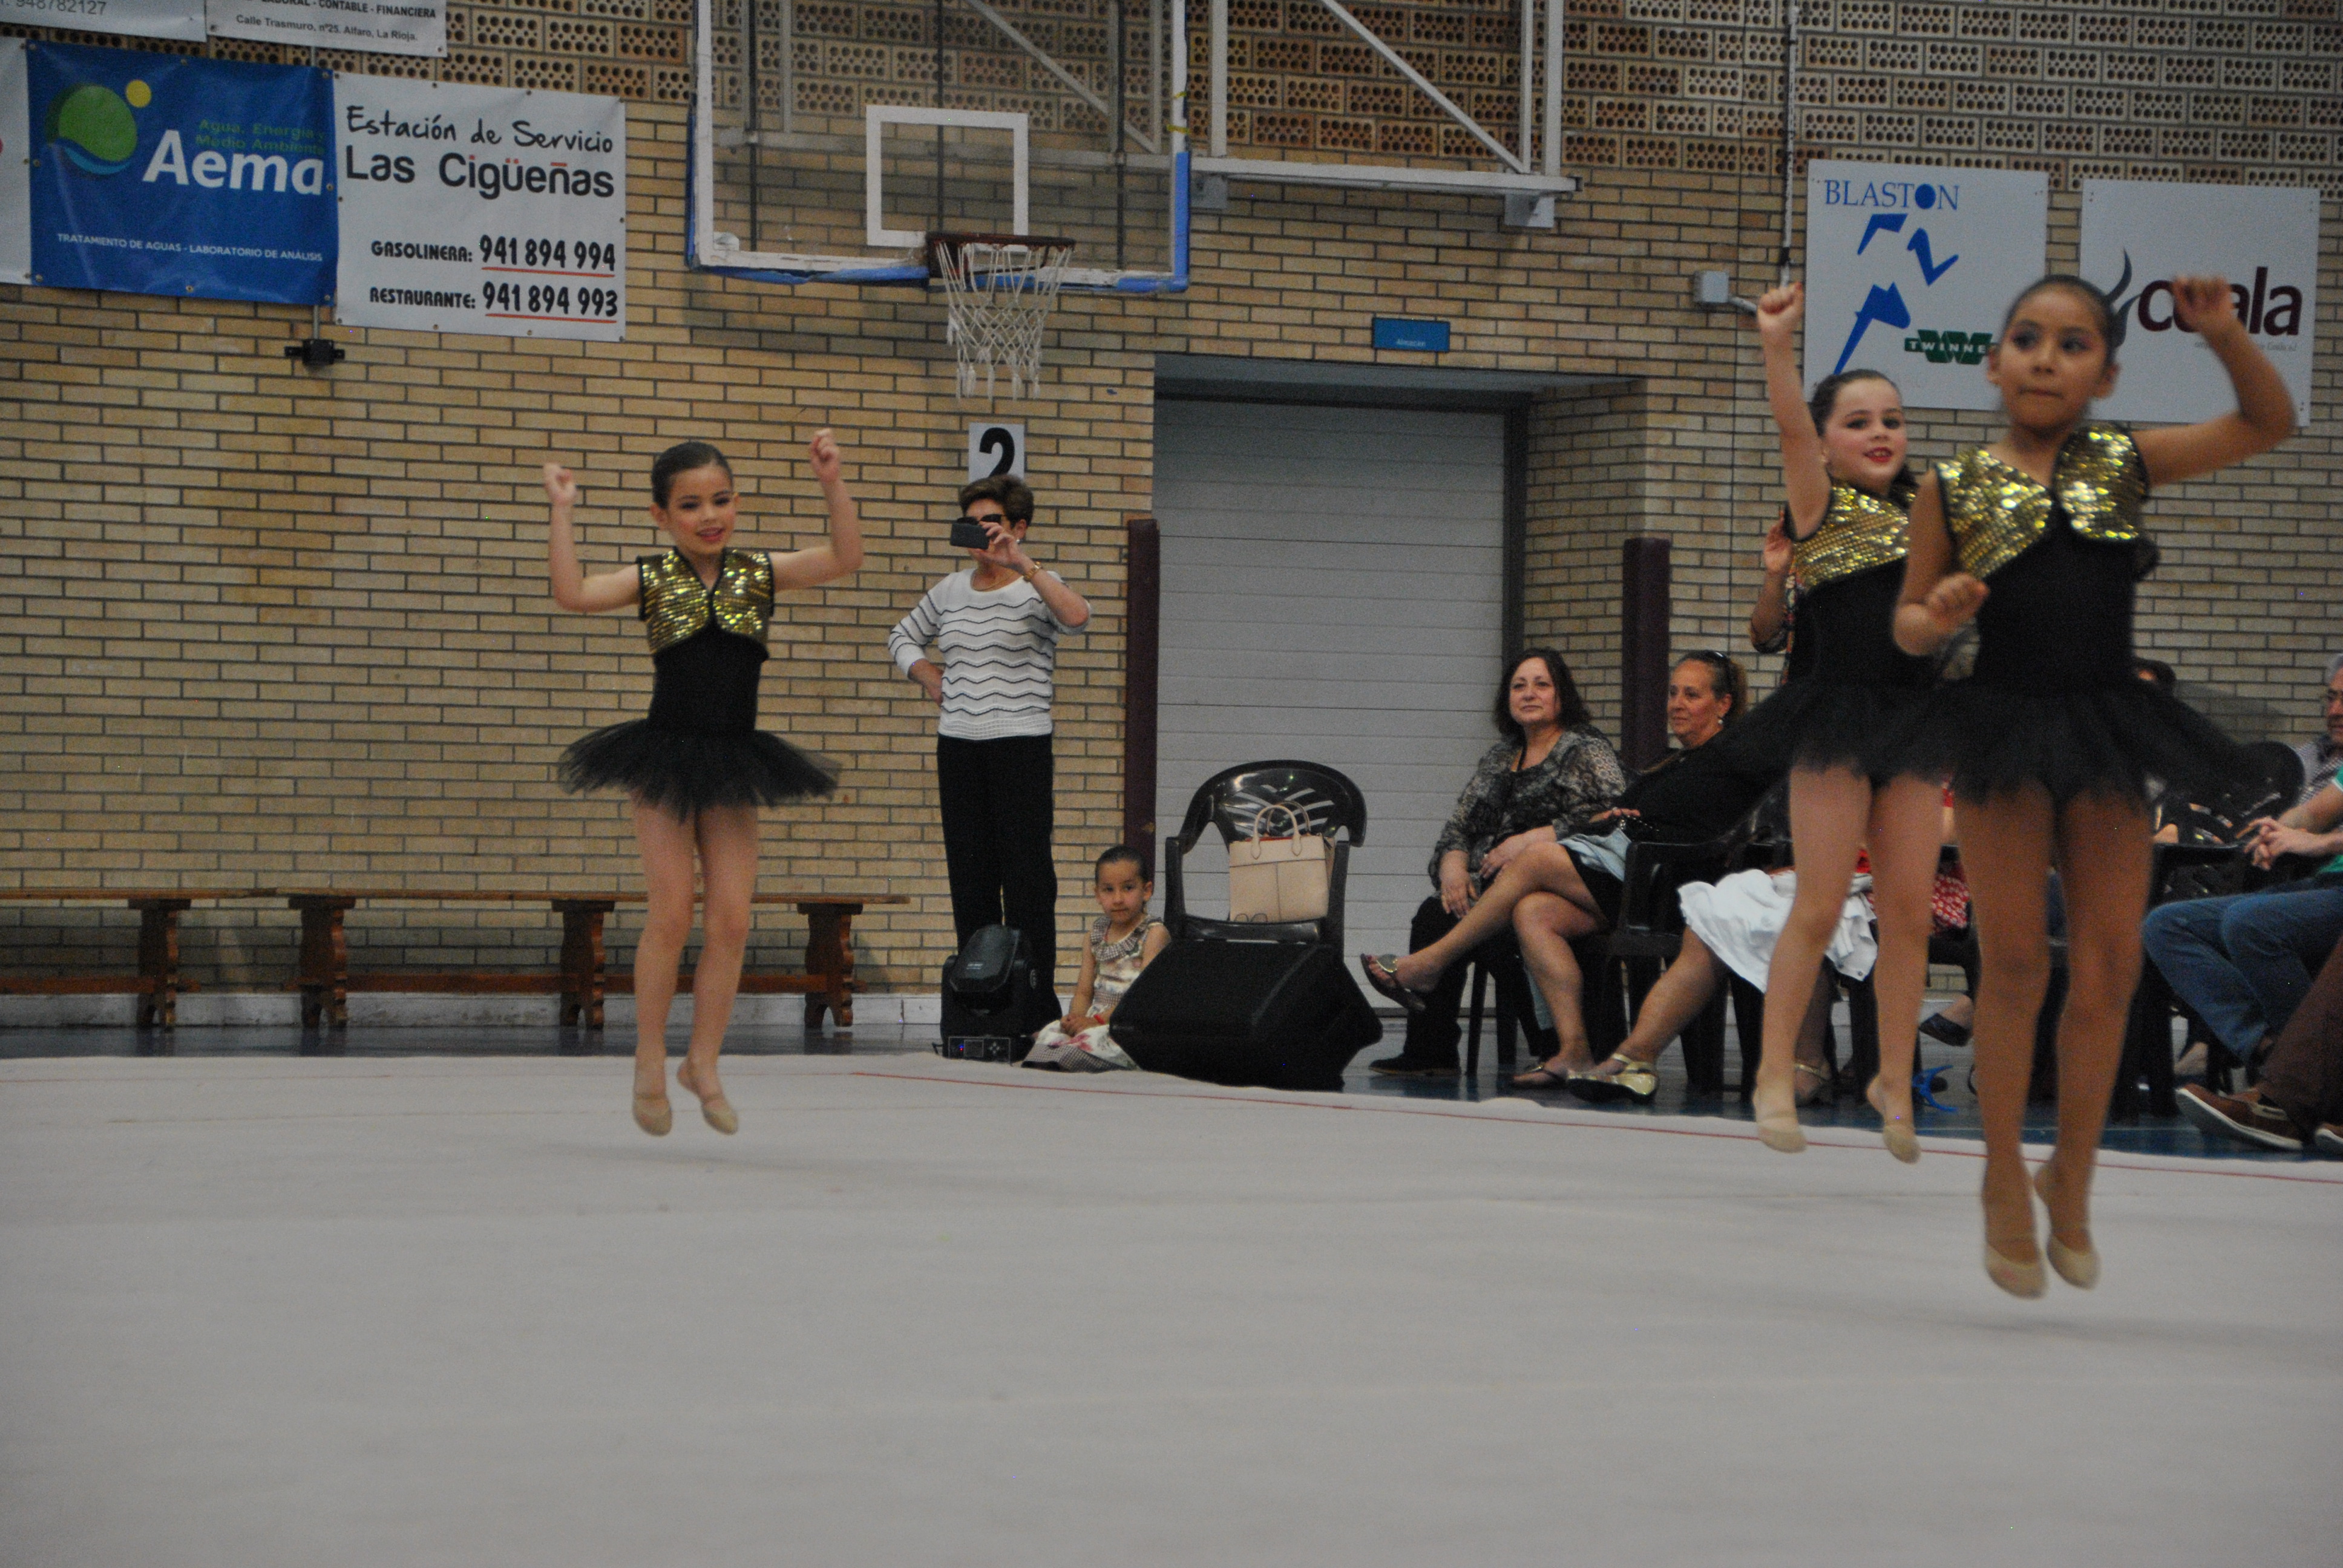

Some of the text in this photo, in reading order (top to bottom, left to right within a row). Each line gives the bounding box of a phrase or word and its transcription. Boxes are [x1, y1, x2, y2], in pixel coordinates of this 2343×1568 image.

[236, 14, 262, 25] Calle
[265, 18, 316, 31] Trasmuro,
[343, 25, 374, 38] Alfaro,
[377, 29, 388, 39] La
[319, 0, 369, 13] CONTABLE
[376, 5, 436, 18] FINANCIERA
[346, 105, 614, 153] Estación de Servicio
[142, 129, 324, 195] Aema
[346, 145, 615, 200] Las Cigüeñas
[57, 233, 127, 248] TRATAMIENTO
[129, 240, 143, 249] DE
[146, 241, 182, 252] AGUAS
[189, 245, 262, 258] LABORATORIO
[264, 249, 278, 258] DE
[371, 235, 615, 272] GASOLINERA: 941 894 994
[370, 281, 618, 317] RESTAURANTE: 941 894 993
[979, 427, 1015, 479] 2
